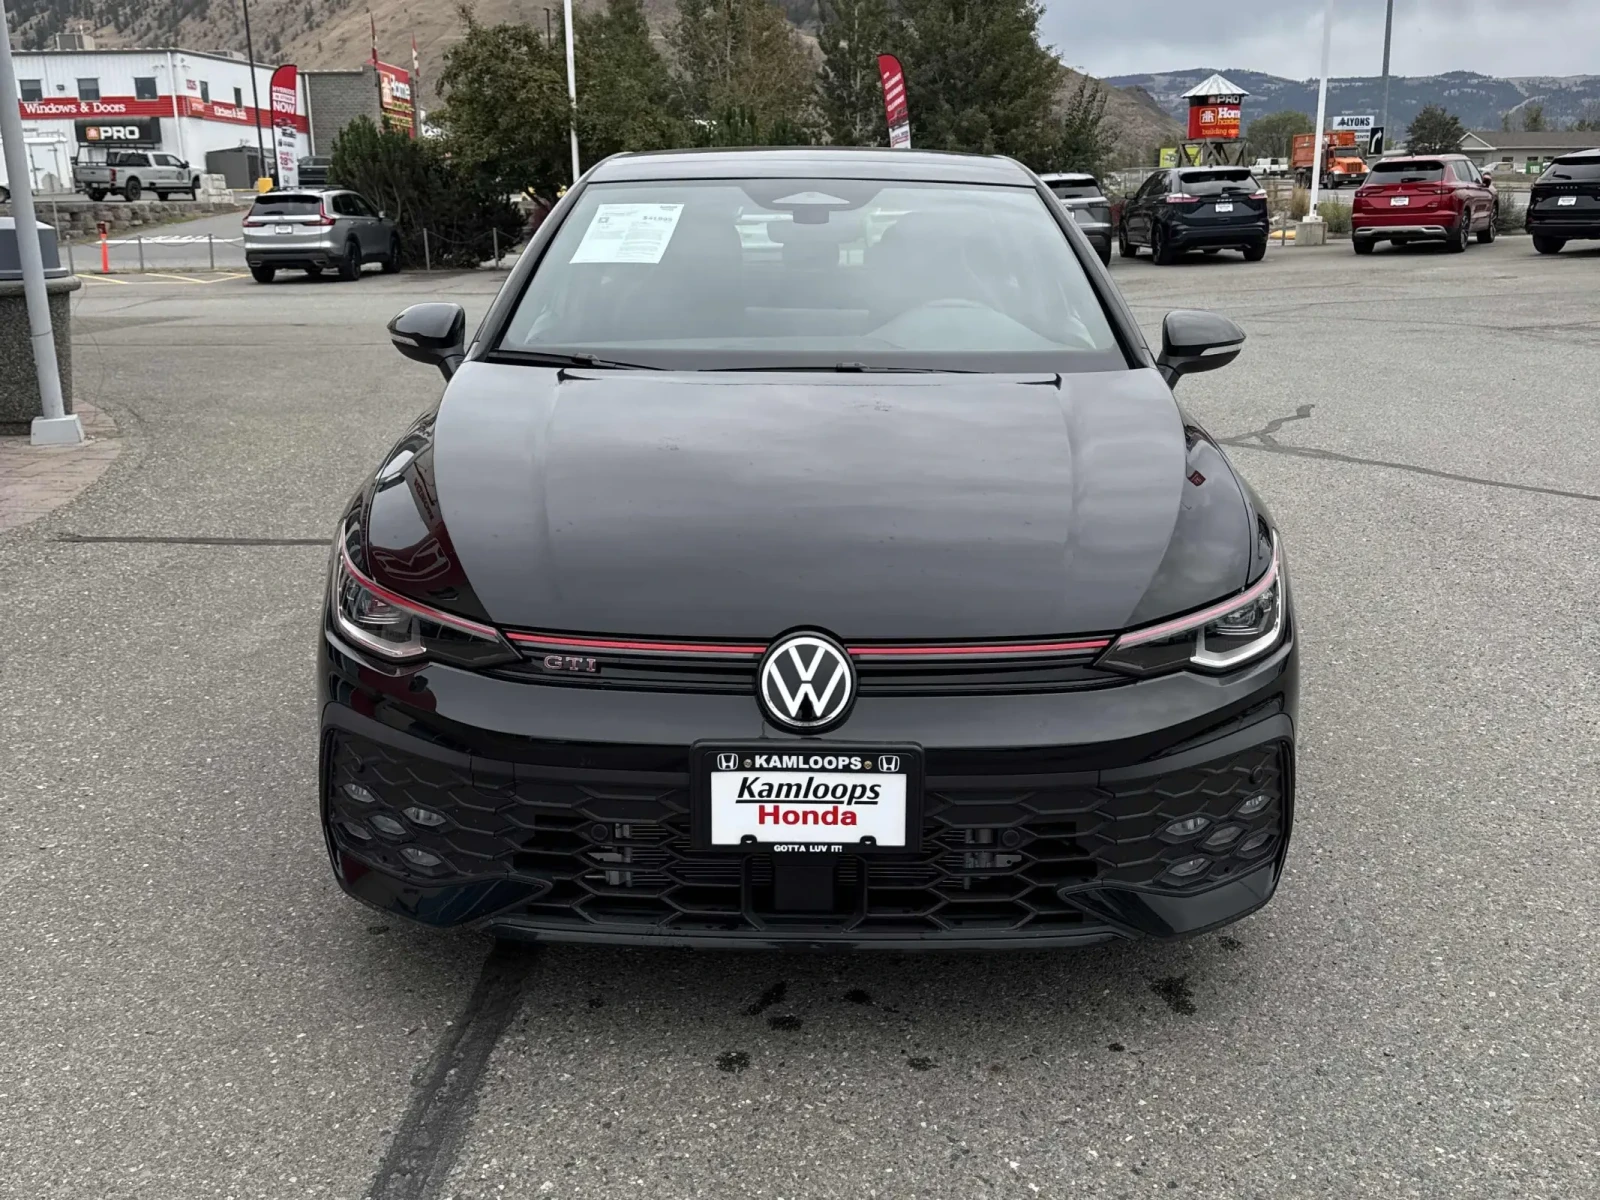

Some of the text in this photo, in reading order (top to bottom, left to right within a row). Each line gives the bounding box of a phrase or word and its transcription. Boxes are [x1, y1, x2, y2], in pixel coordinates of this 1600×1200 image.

[1217, 95, 1240, 104] PRO
[23, 102, 126, 114] Windows & Doors
[272, 100, 296, 114] NOW
[1217, 107, 1241, 119] Hom
[1346, 117, 1371, 127] LYONS
[99, 126, 140, 140] PRO
[543, 655, 597, 673] GTI
[754, 754, 862, 770] KAMLOOPS
[737, 776, 882, 806] Kamloops
[758, 804, 858, 826] Honda
[773, 844, 843, 853] GOTTA LUV IT!
